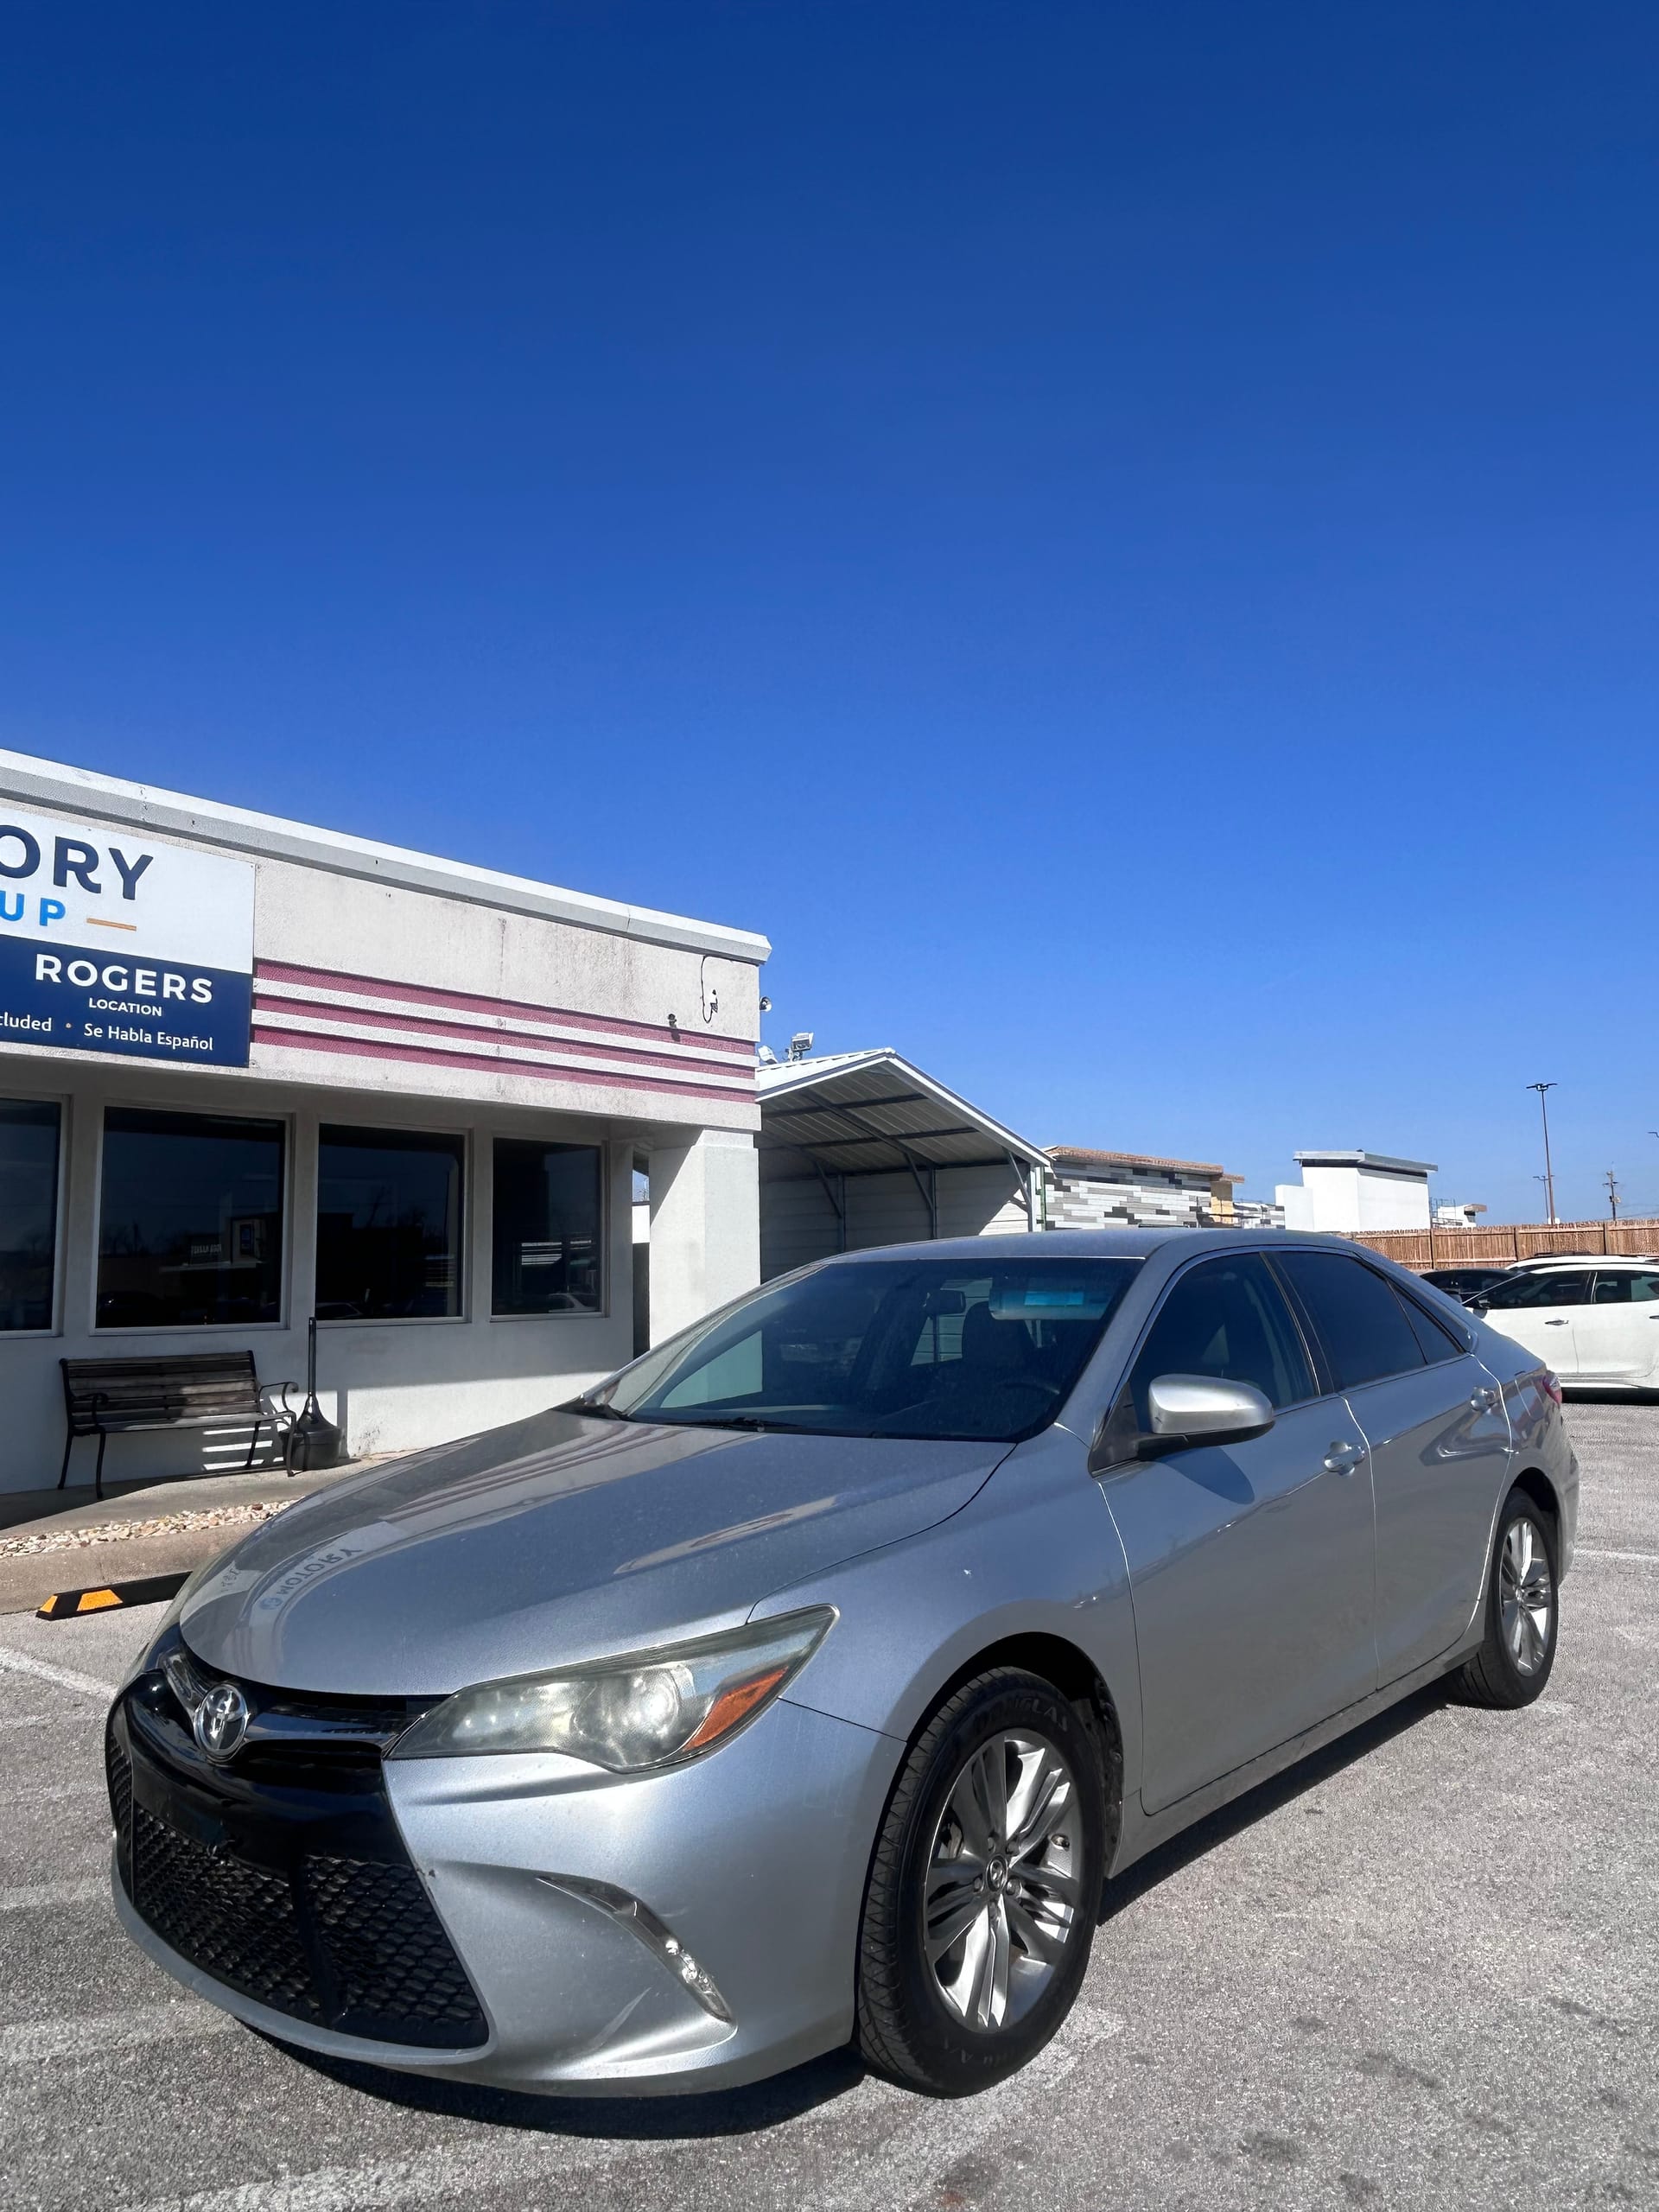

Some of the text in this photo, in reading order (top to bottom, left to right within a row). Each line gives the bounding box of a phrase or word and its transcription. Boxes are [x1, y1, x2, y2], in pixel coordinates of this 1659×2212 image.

[0, 890, 66, 926] UP
[35, 953, 213, 1003] ROGERS
[89, 997, 162, 1016] LOCATION
[84, 1023, 213, 1051] Se Habla Español
